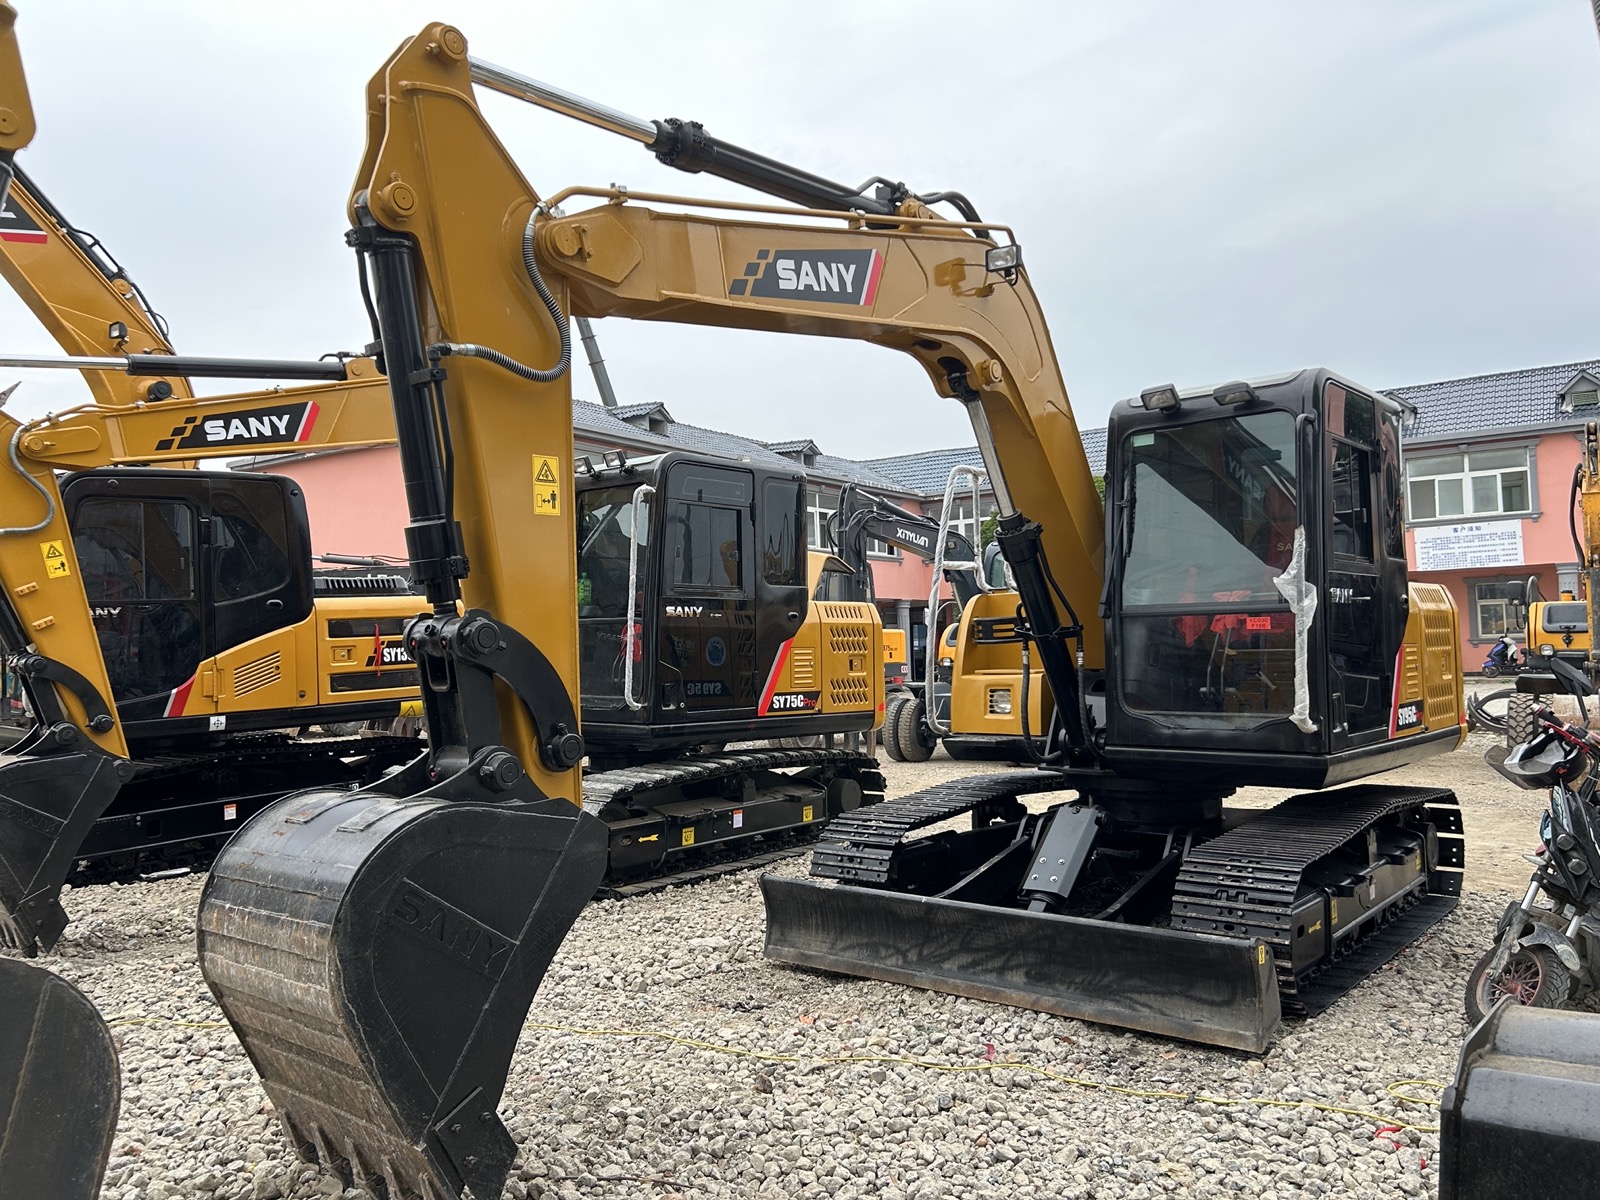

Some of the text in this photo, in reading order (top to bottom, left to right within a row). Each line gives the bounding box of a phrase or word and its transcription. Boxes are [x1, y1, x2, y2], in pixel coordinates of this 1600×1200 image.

[776, 258, 857, 293] SANY
[204, 414, 291, 442] SANY
[665, 606, 703, 618] SANY
[383, 647, 412, 662] SY13
[391, 889, 510, 969] SANY
